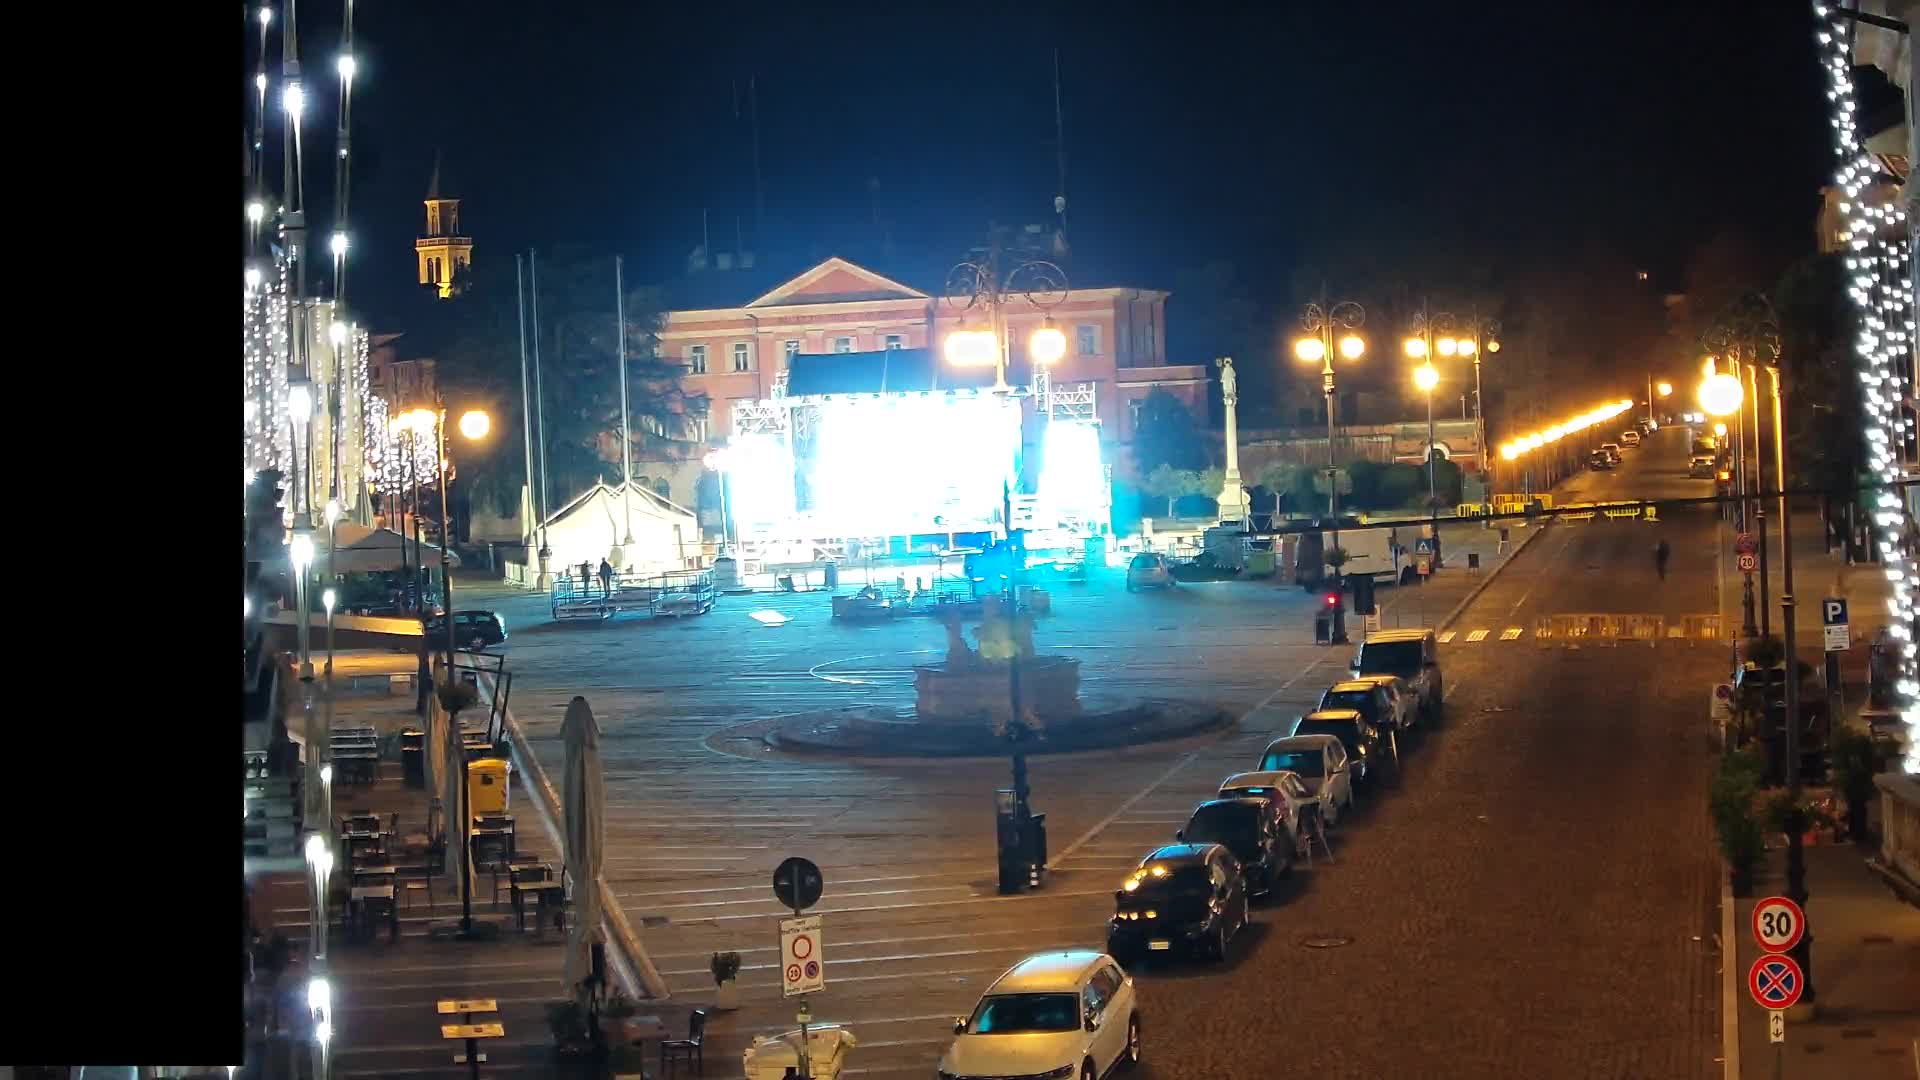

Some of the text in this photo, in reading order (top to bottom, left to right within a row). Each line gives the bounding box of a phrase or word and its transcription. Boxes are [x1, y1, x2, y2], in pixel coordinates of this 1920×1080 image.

[1742, 557, 1752, 566] 20
[1828, 602, 1842, 621] P
[1763, 912, 1791, 937] 30
